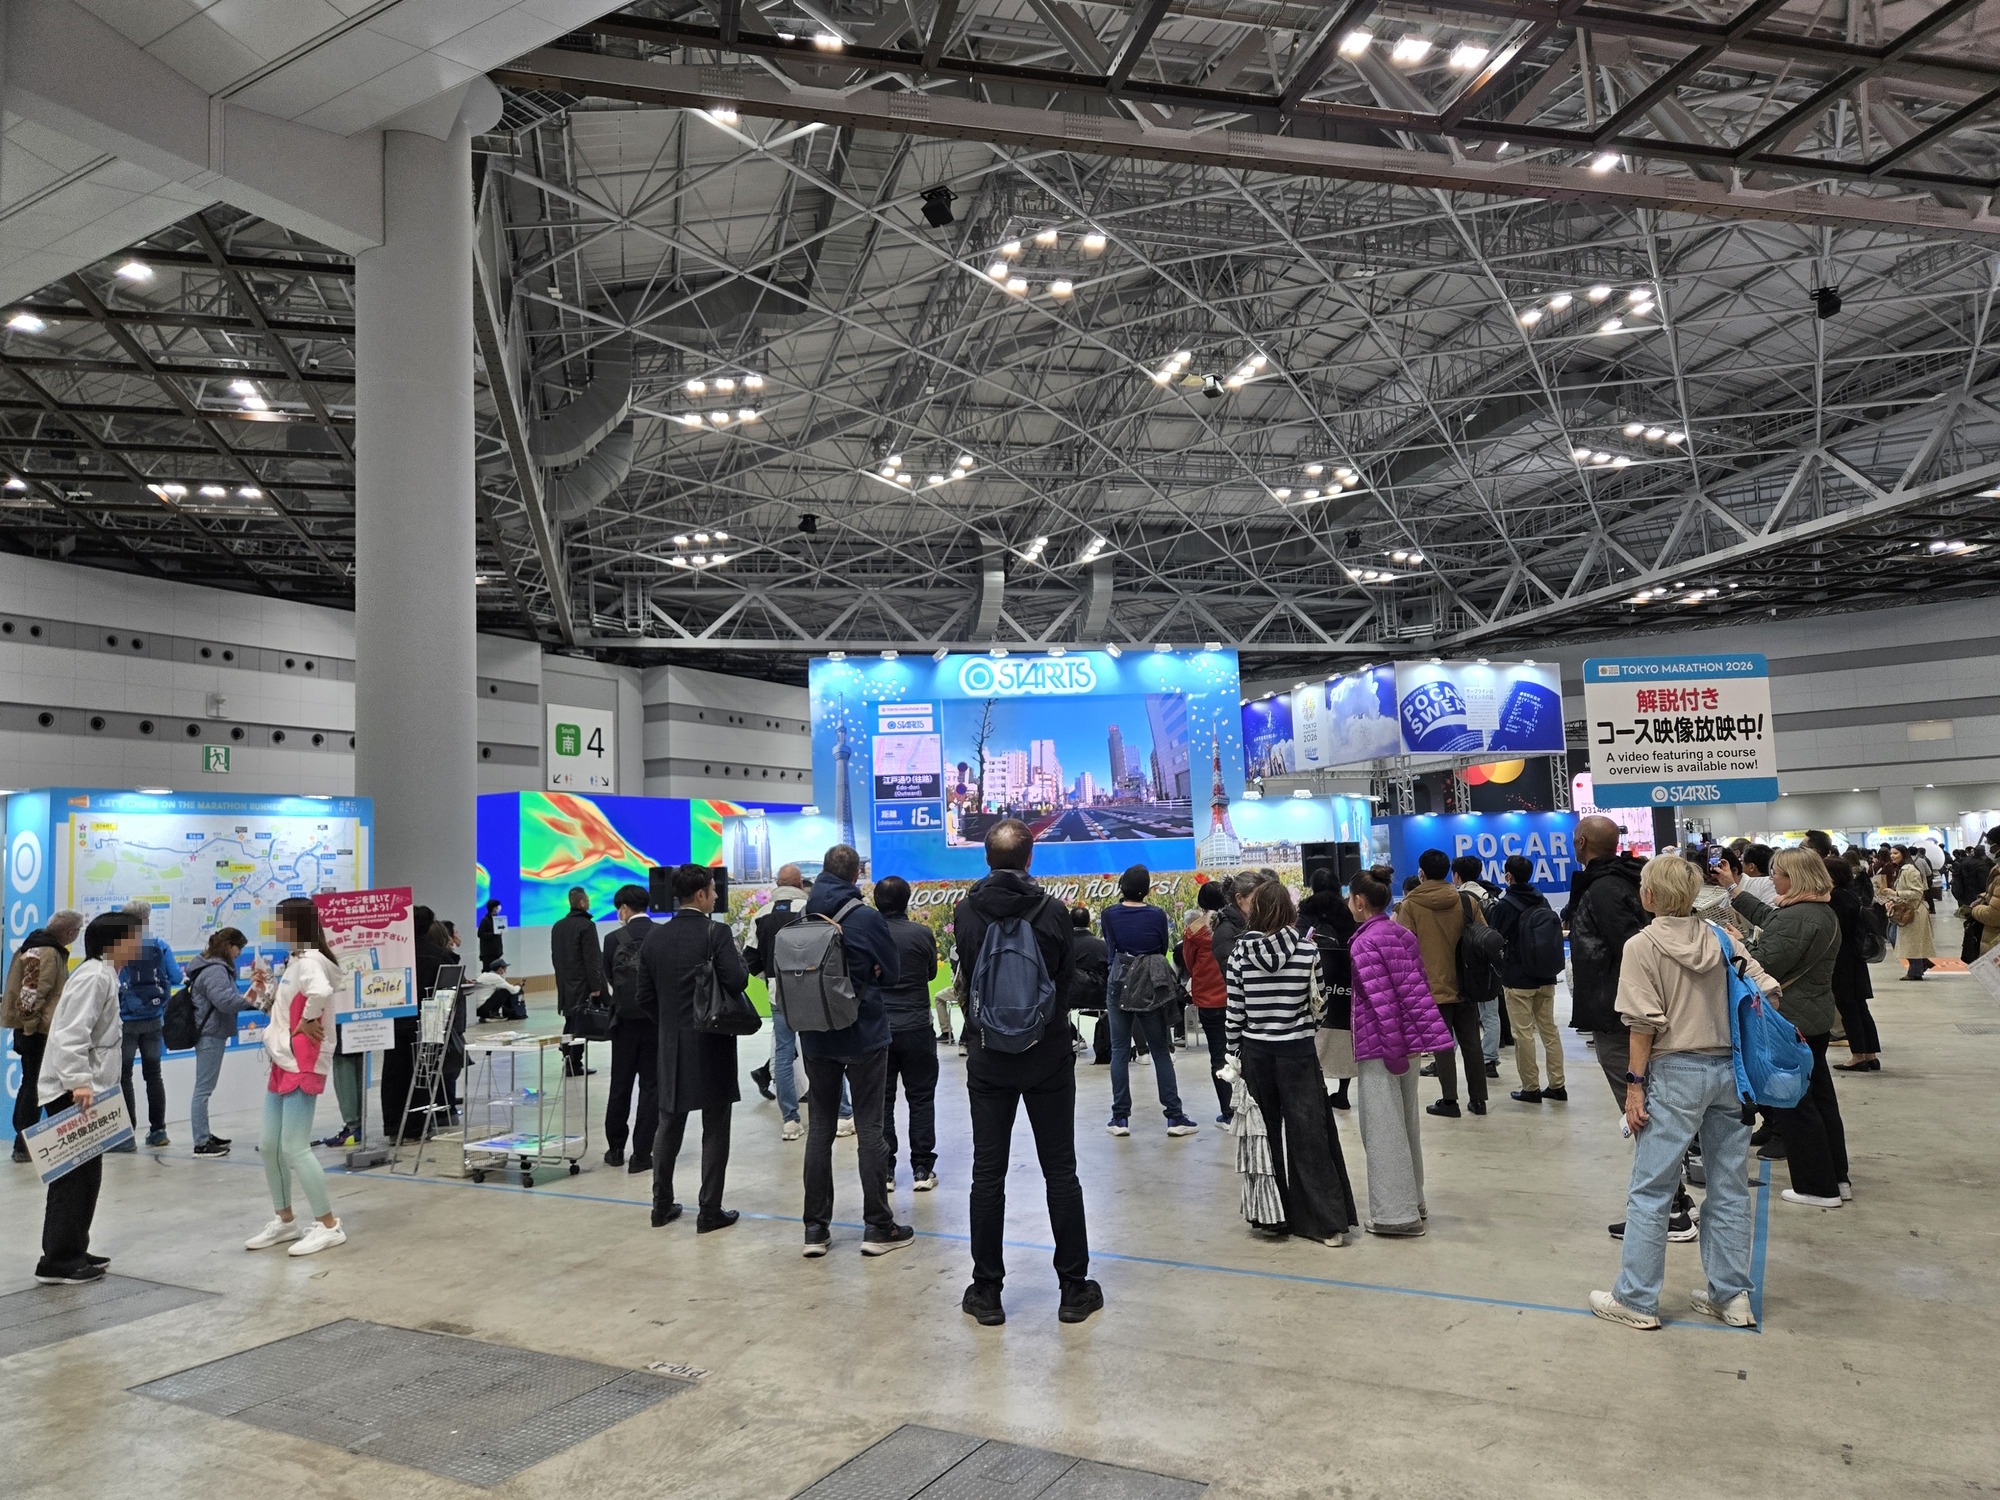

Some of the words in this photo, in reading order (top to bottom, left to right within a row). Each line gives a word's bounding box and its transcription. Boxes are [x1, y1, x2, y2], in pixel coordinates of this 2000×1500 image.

[998, 661, 1092, 690] STARTS
[1621, 664, 1659, 675] TOKYO
[1661, 662, 1723, 674] MARATHON
[1725, 661, 1754, 671] 2026
[1636, 687, 1719, 713] 解説付き
[1303, 733, 1318, 743] 2026
[1597, 713, 1764, 745] コース映像放映中!
[562, 735, 575, 754] 南
[587, 727, 605, 758] 4
[1606, 752, 1615, 762] A
[1618, 751, 1649, 762] video
[1652, 749, 1704, 761] featuring
[1706, 751, 1714, 759] a
[1716, 748, 1757, 758] course
[1609, 762, 1660, 775] overview
[1663, 763, 1674, 773] is
[1677, 760, 1728, 773] available
[1730, 759, 1758, 771] now!
[1670, 785, 1721, 802] STARTS
[160, 800, 177, 810] ON
[178, 800, 195, 810] THE
[197, 801, 247, 811] MARATHON
[911, 806, 930, 827] 16
[328, 893, 390, 907] メッセージを書いて
[907, 886, 967, 906] loom
[365, 979, 402, 995] Smile!
[1326, 984, 1352, 996] eles
[56, 1108, 99, 1137] 解説付き
[38, 1107, 122, 1159] コース映像放映中!
